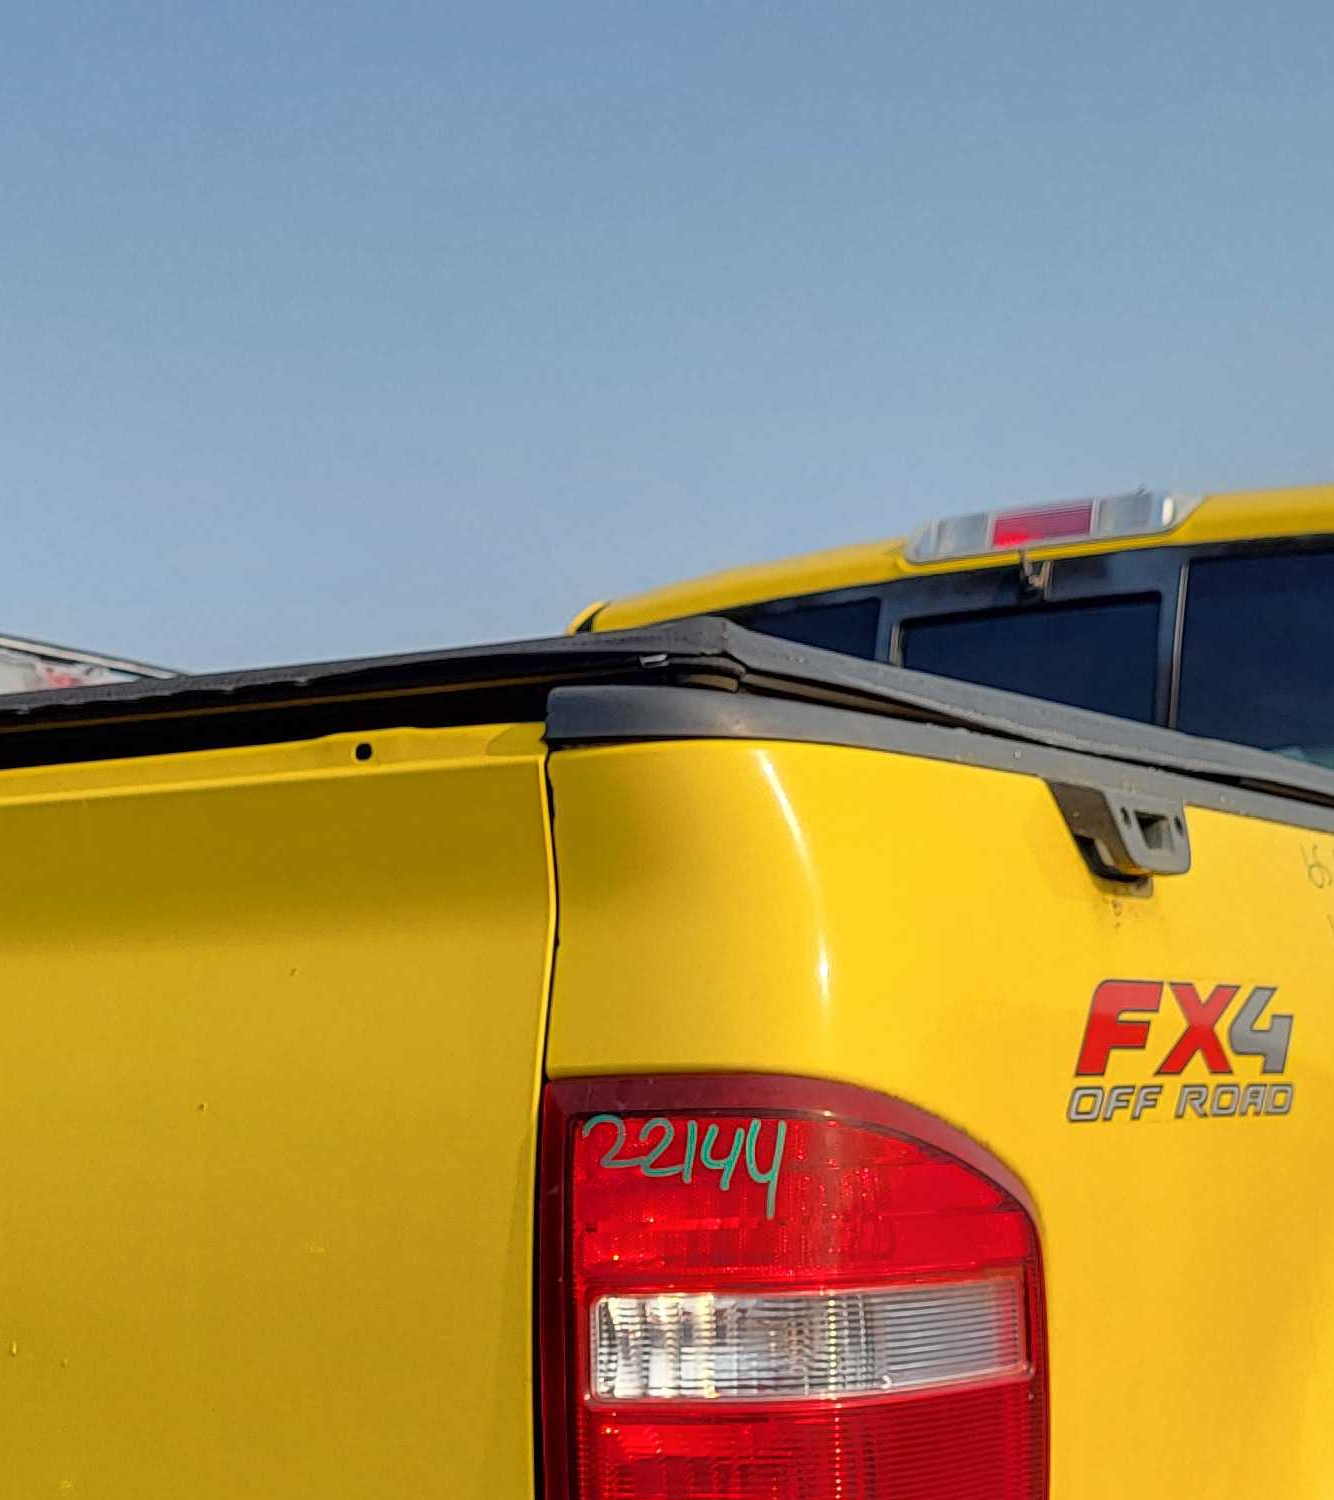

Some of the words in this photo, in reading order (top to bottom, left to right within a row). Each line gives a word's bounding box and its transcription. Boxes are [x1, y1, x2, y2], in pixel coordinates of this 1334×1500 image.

[1074, 979, 1294, 1077] FX4
[1067, 1084, 1164, 1124] OFF
[1174, 1083, 1294, 1119] ROAD
[582, 1113, 787, 1220] 22144
